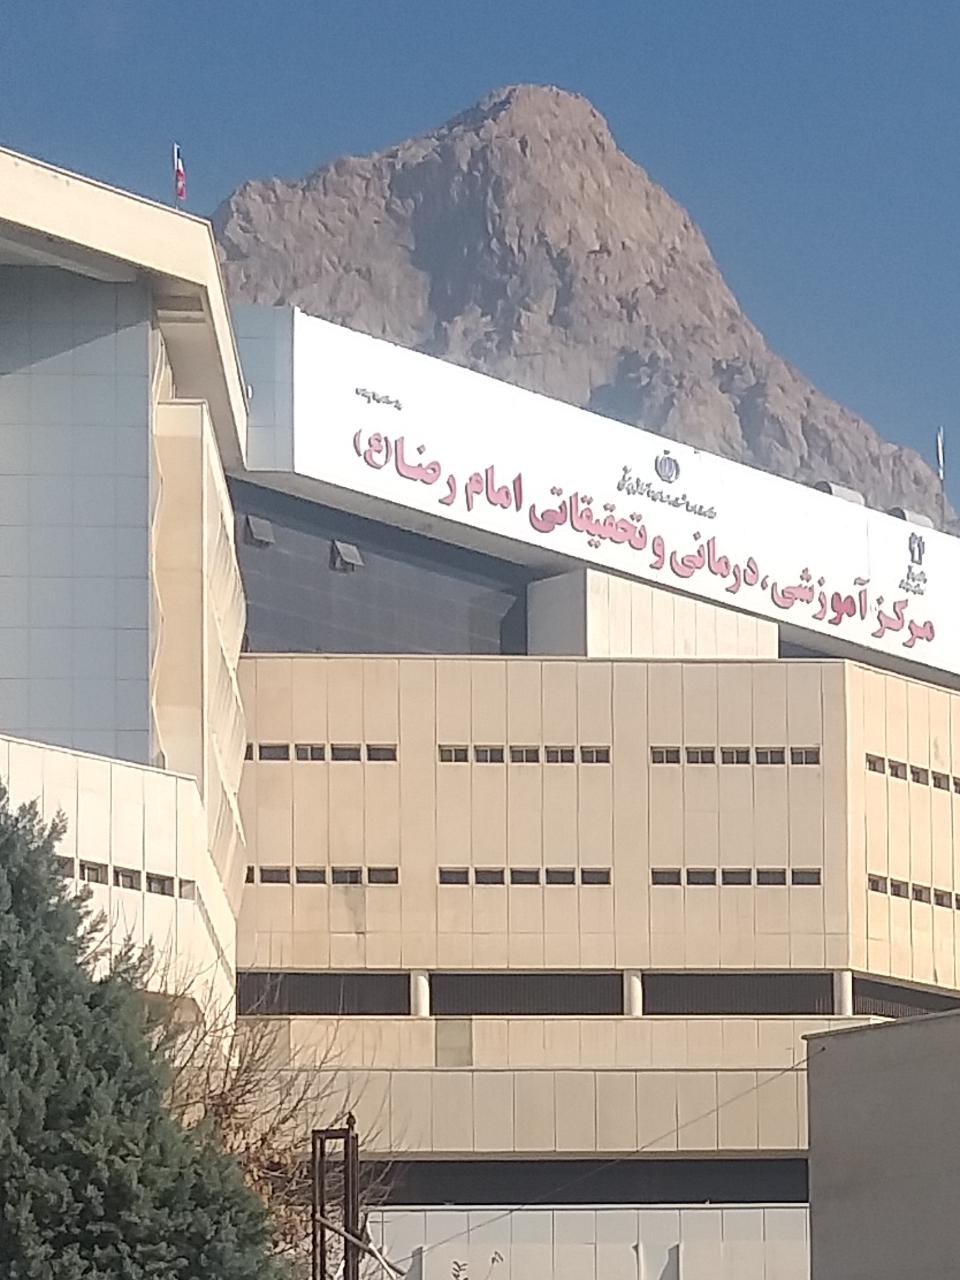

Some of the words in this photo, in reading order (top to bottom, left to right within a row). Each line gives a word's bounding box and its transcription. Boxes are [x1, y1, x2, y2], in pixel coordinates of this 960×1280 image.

[465, 464, 523, 512] امام
[529, 486, 648, 550] تحقیقاتی
[650, 536, 666, 570] و
[670, 531, 761, 594] درمانی
[870, 596, 935, 648] مرکز
